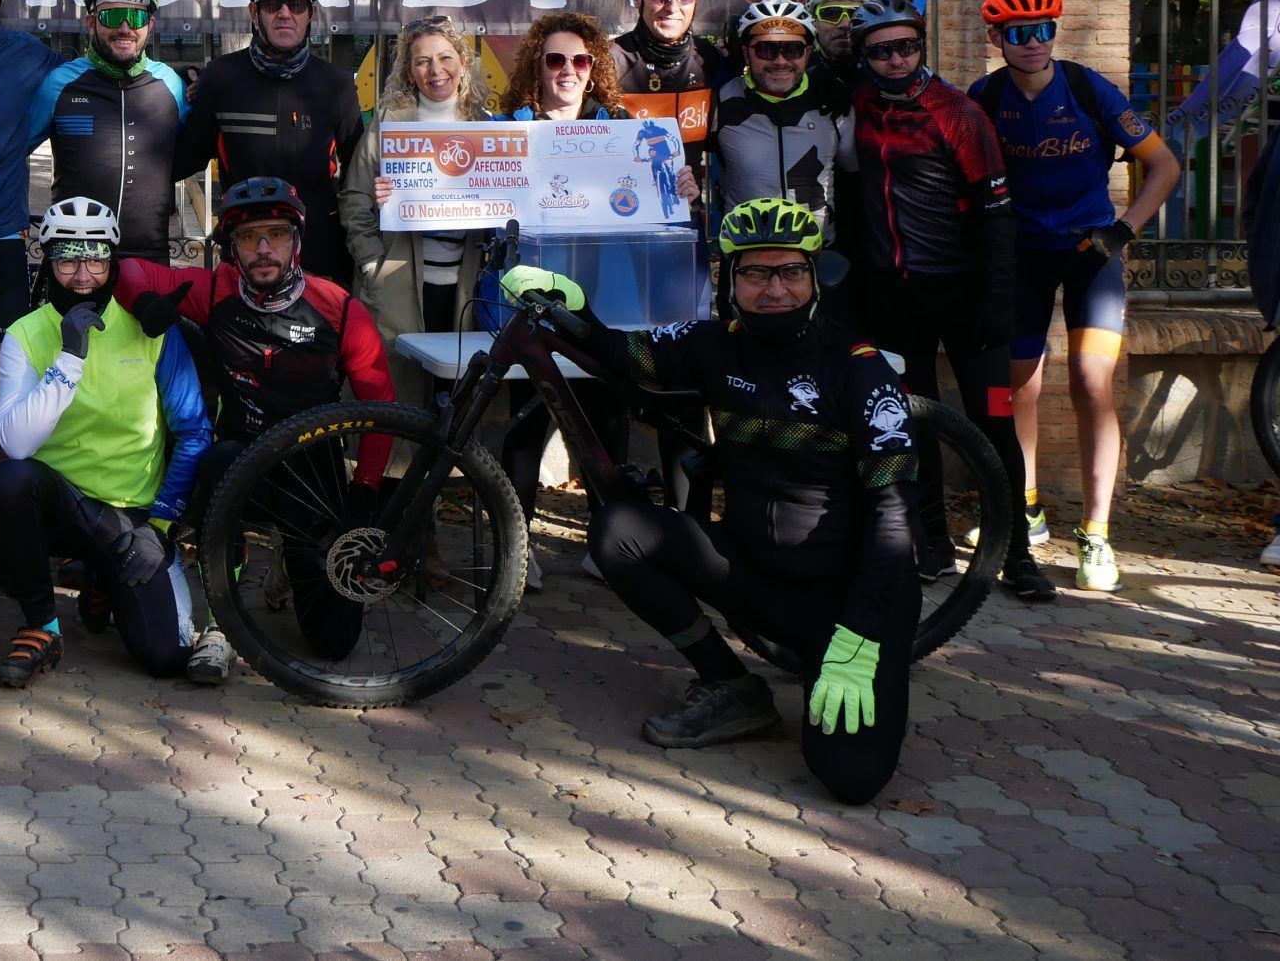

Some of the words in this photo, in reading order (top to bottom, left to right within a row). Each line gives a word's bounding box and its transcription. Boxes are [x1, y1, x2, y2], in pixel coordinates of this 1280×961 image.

[760, 19, 780, 30] BEER
[383, 137, 435, 154] RUTA
[482, 137, 525, 153] BTT
[549, 138, 595, 156] 550
[1001, 130, 1092, 158] ocuBike
[385, 161, 433, 174] BENEFICA
[474, 160, 522, 173] AFECTADOS
[469, 177, 491, 188] DANA
[491, 177, 529, 187] VALENCIA
[401, 204, 415, 219] 10
[419, 203, 482, 218] Noviembre
[485, 202, 514, 216] 2024
[298, 421, 375, 443] MAXXIS
